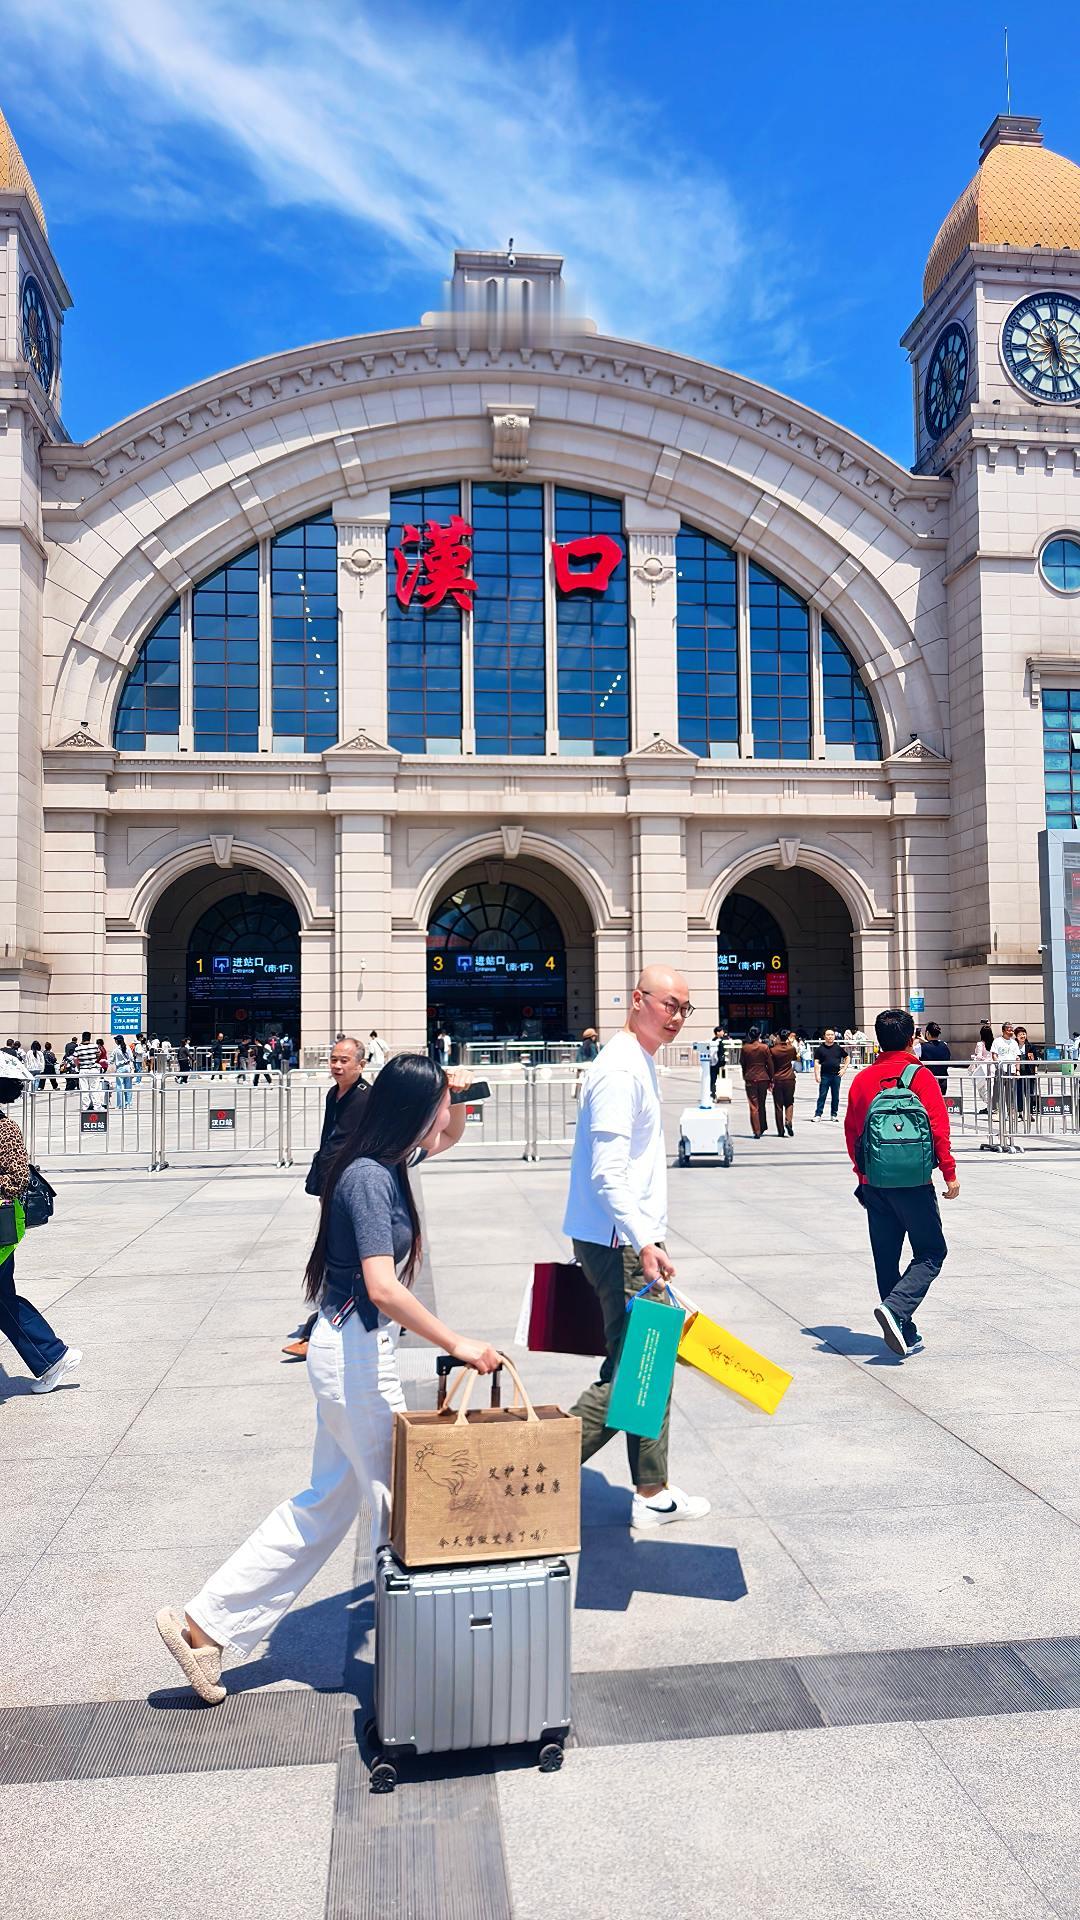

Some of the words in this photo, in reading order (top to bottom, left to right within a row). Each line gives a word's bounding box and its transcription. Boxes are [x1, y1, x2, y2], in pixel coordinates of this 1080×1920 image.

[393, 515, 623, 611] 漢口
[196, 958, 203, 973] 1
[232, 957, 264, 967] 进站口
[433, 956, 444, 971] 3
[475, 955, 506, 966] 进站口
[545, 956, 556, 971] 4
[718, 955, 737, 965] 站口
[771, 955, 782, 970] 6
[947, 1105, 960, 1113] 口站
[83, 1121, 105, 1129] 汉口站
